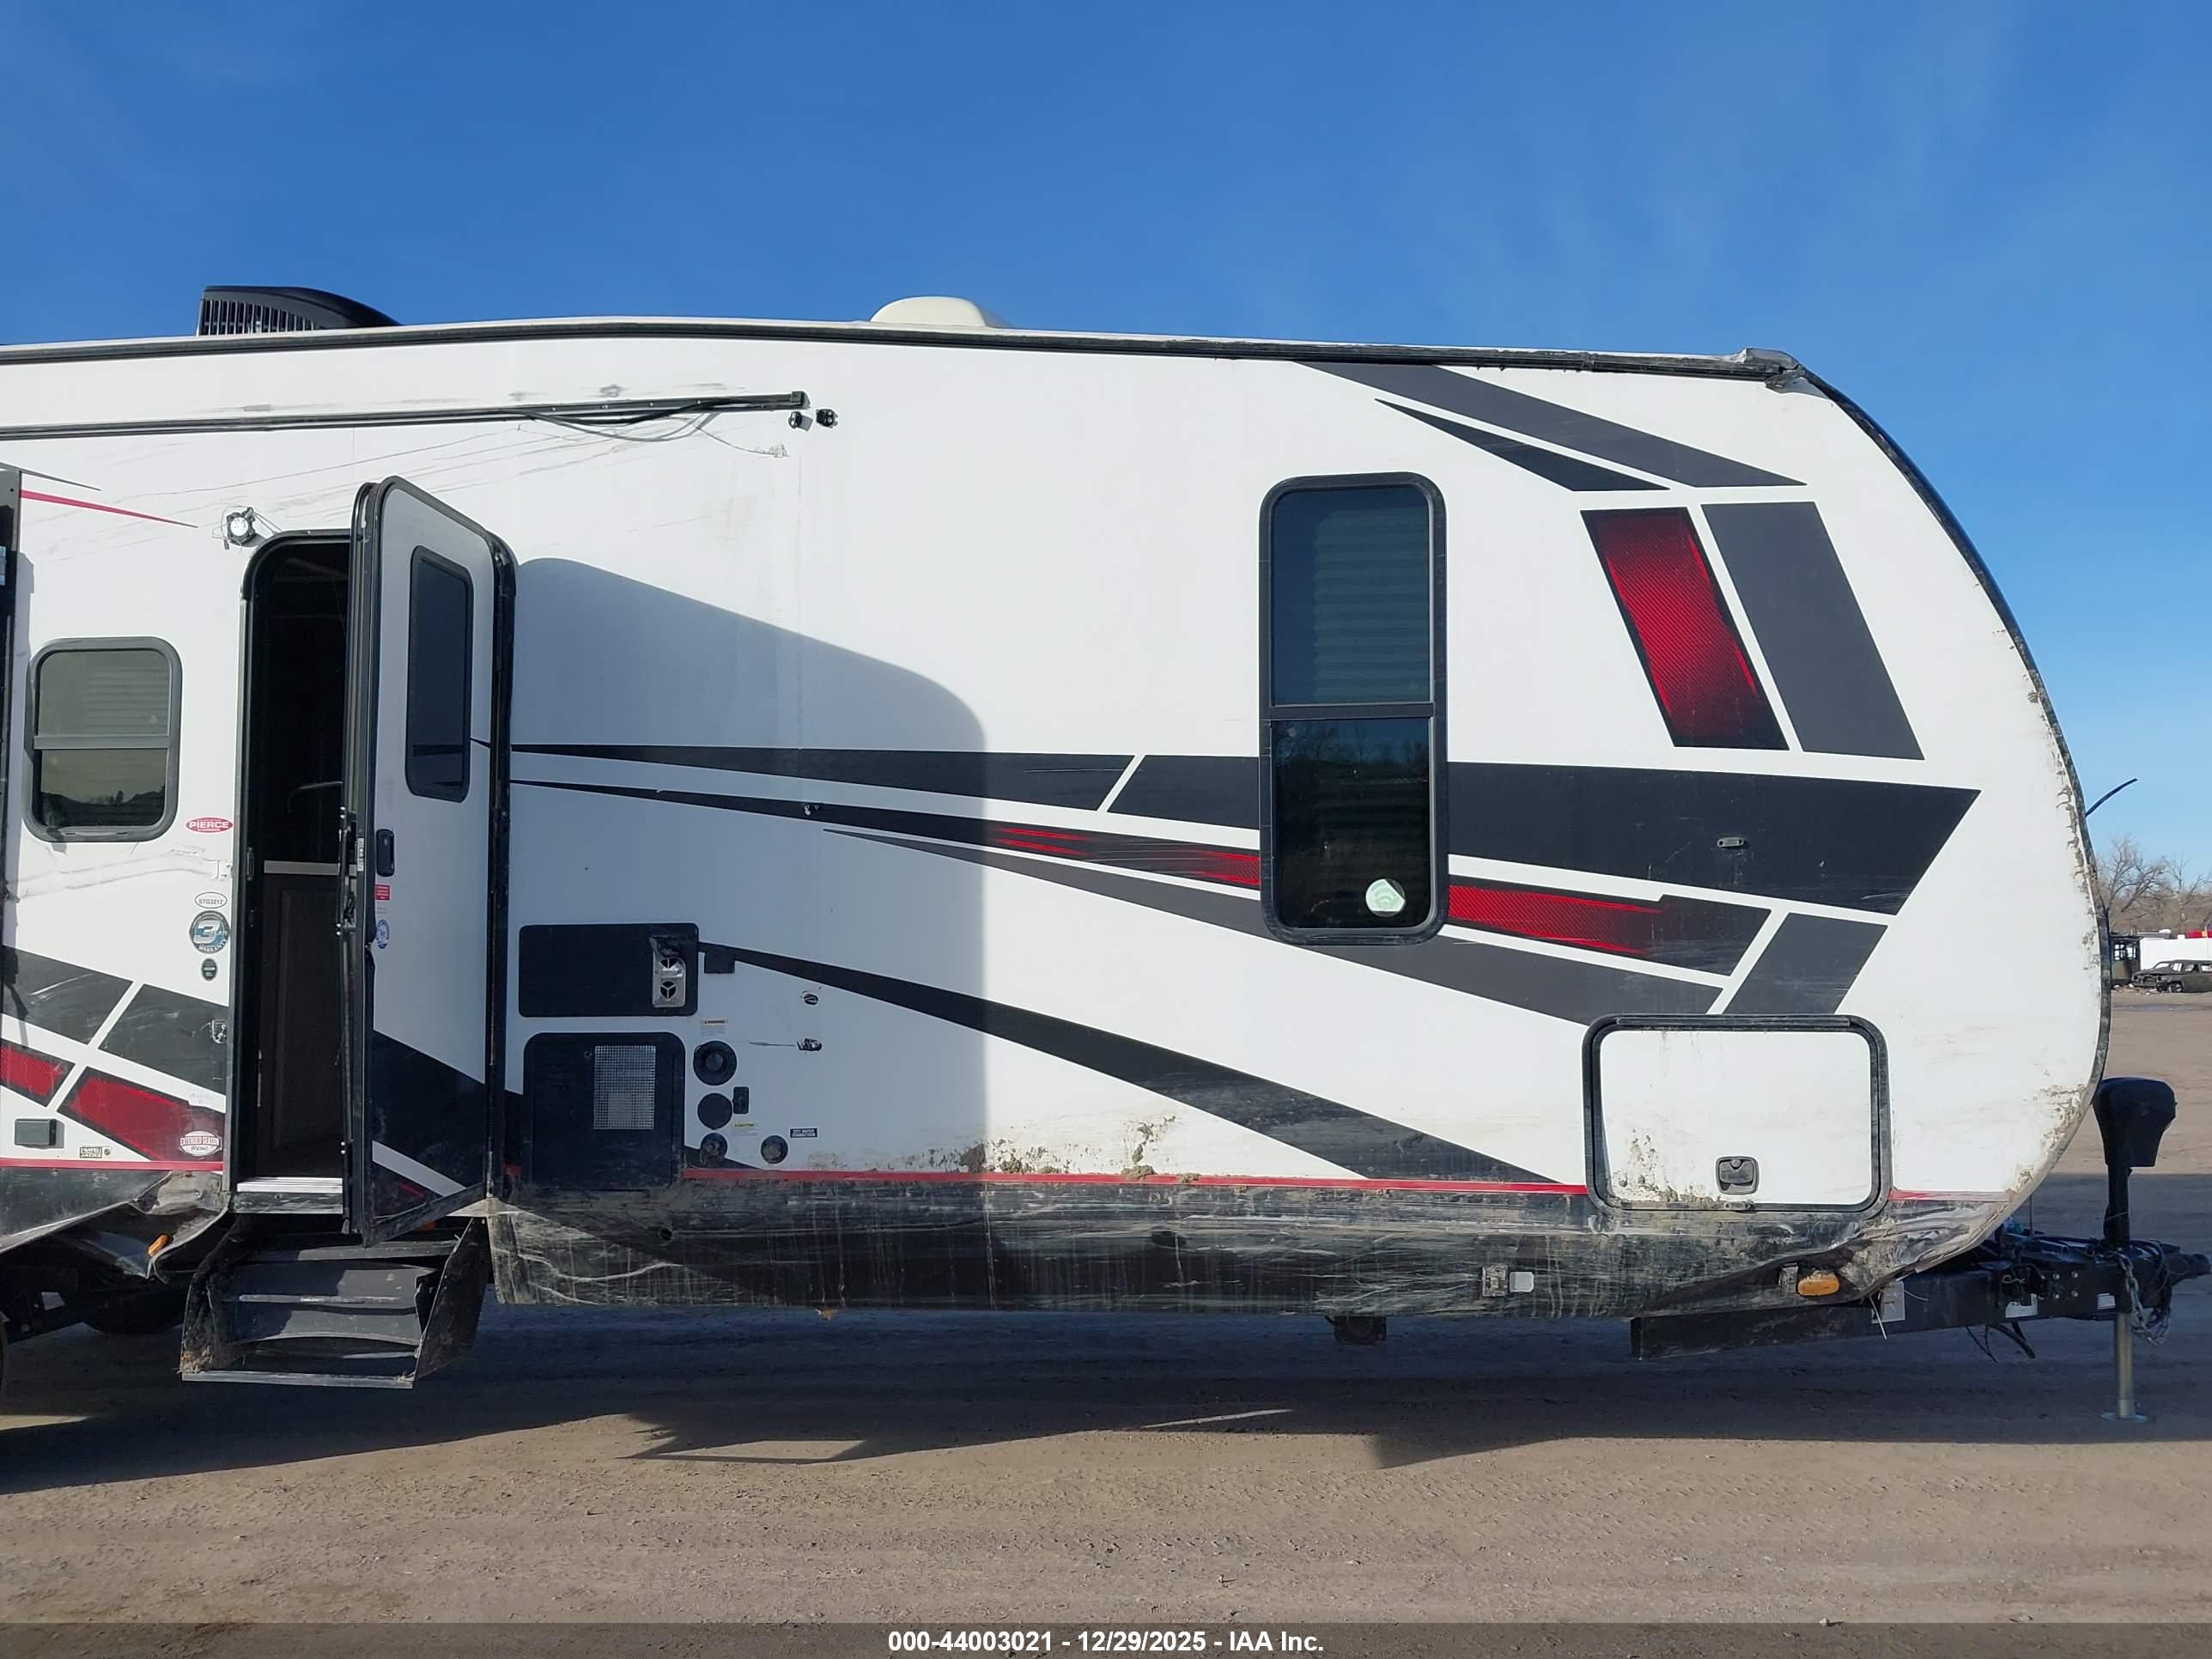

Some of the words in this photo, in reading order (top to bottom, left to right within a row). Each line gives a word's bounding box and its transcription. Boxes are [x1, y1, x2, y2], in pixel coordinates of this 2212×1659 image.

[193, 920, 221, 944] 3
[198, 937, 228, 952] WARRANTY
[180, 1136, 202, 1146] EXTENDED
[203, 1136, 219, 1146] SEASON
